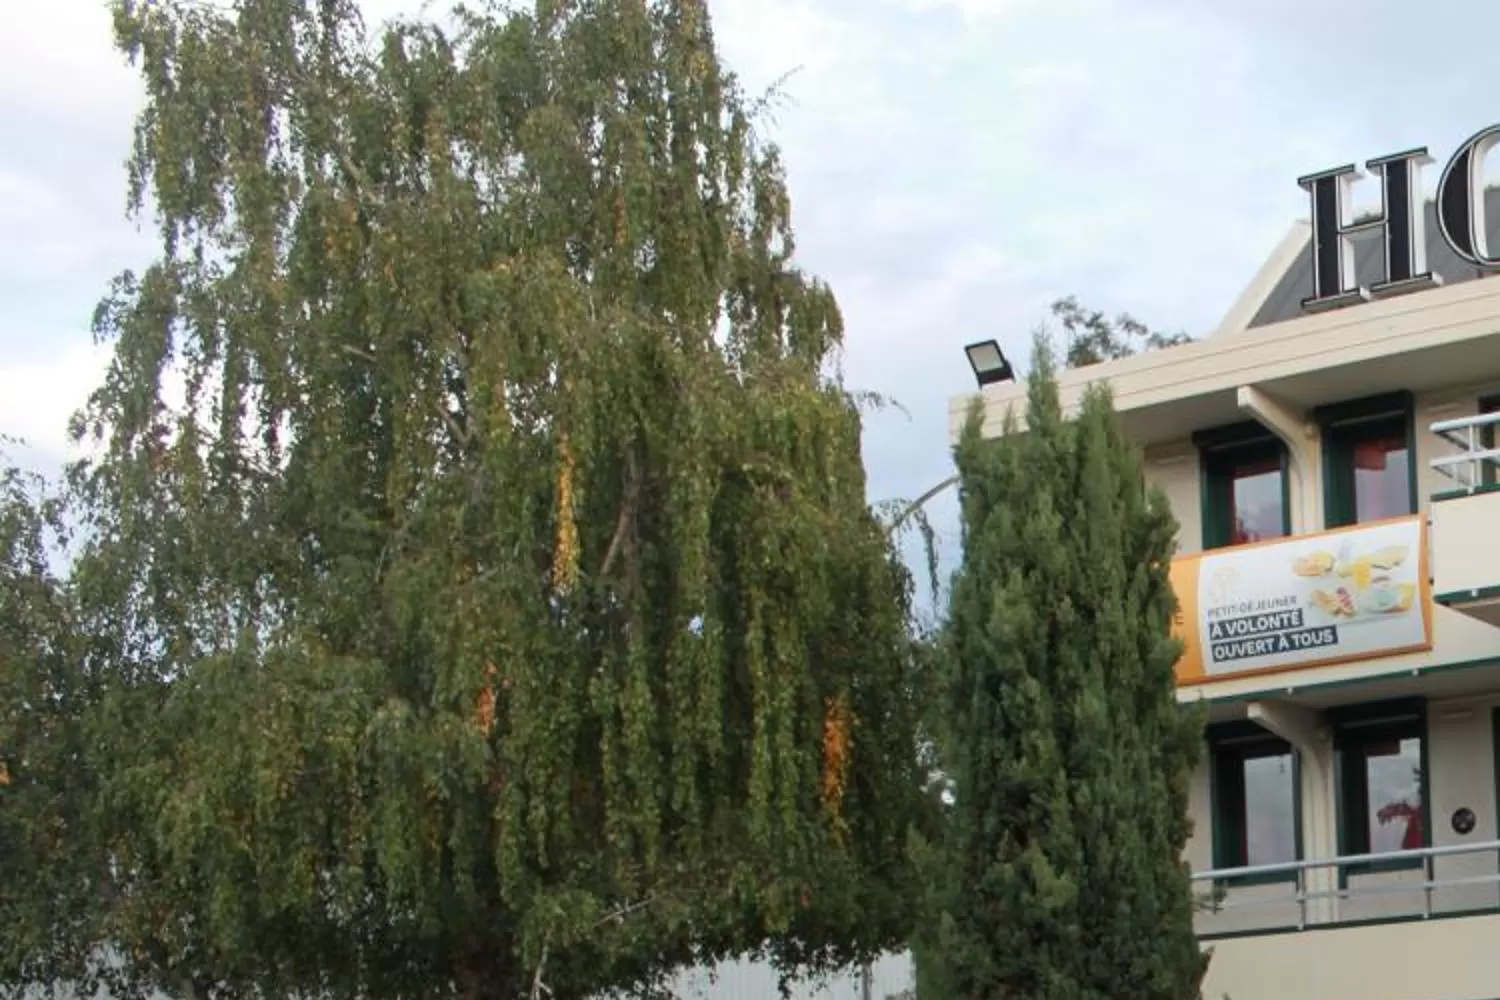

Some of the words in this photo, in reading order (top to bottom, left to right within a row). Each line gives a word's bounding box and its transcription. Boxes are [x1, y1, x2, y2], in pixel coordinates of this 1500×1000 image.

[1225, 610, 1301, 636] VOLONTÉ
[1215, 637, 1275, 659] OUVERT
[1278, 632, 1290, 651] À
[1291, 628, 1334, 646] TOUS
